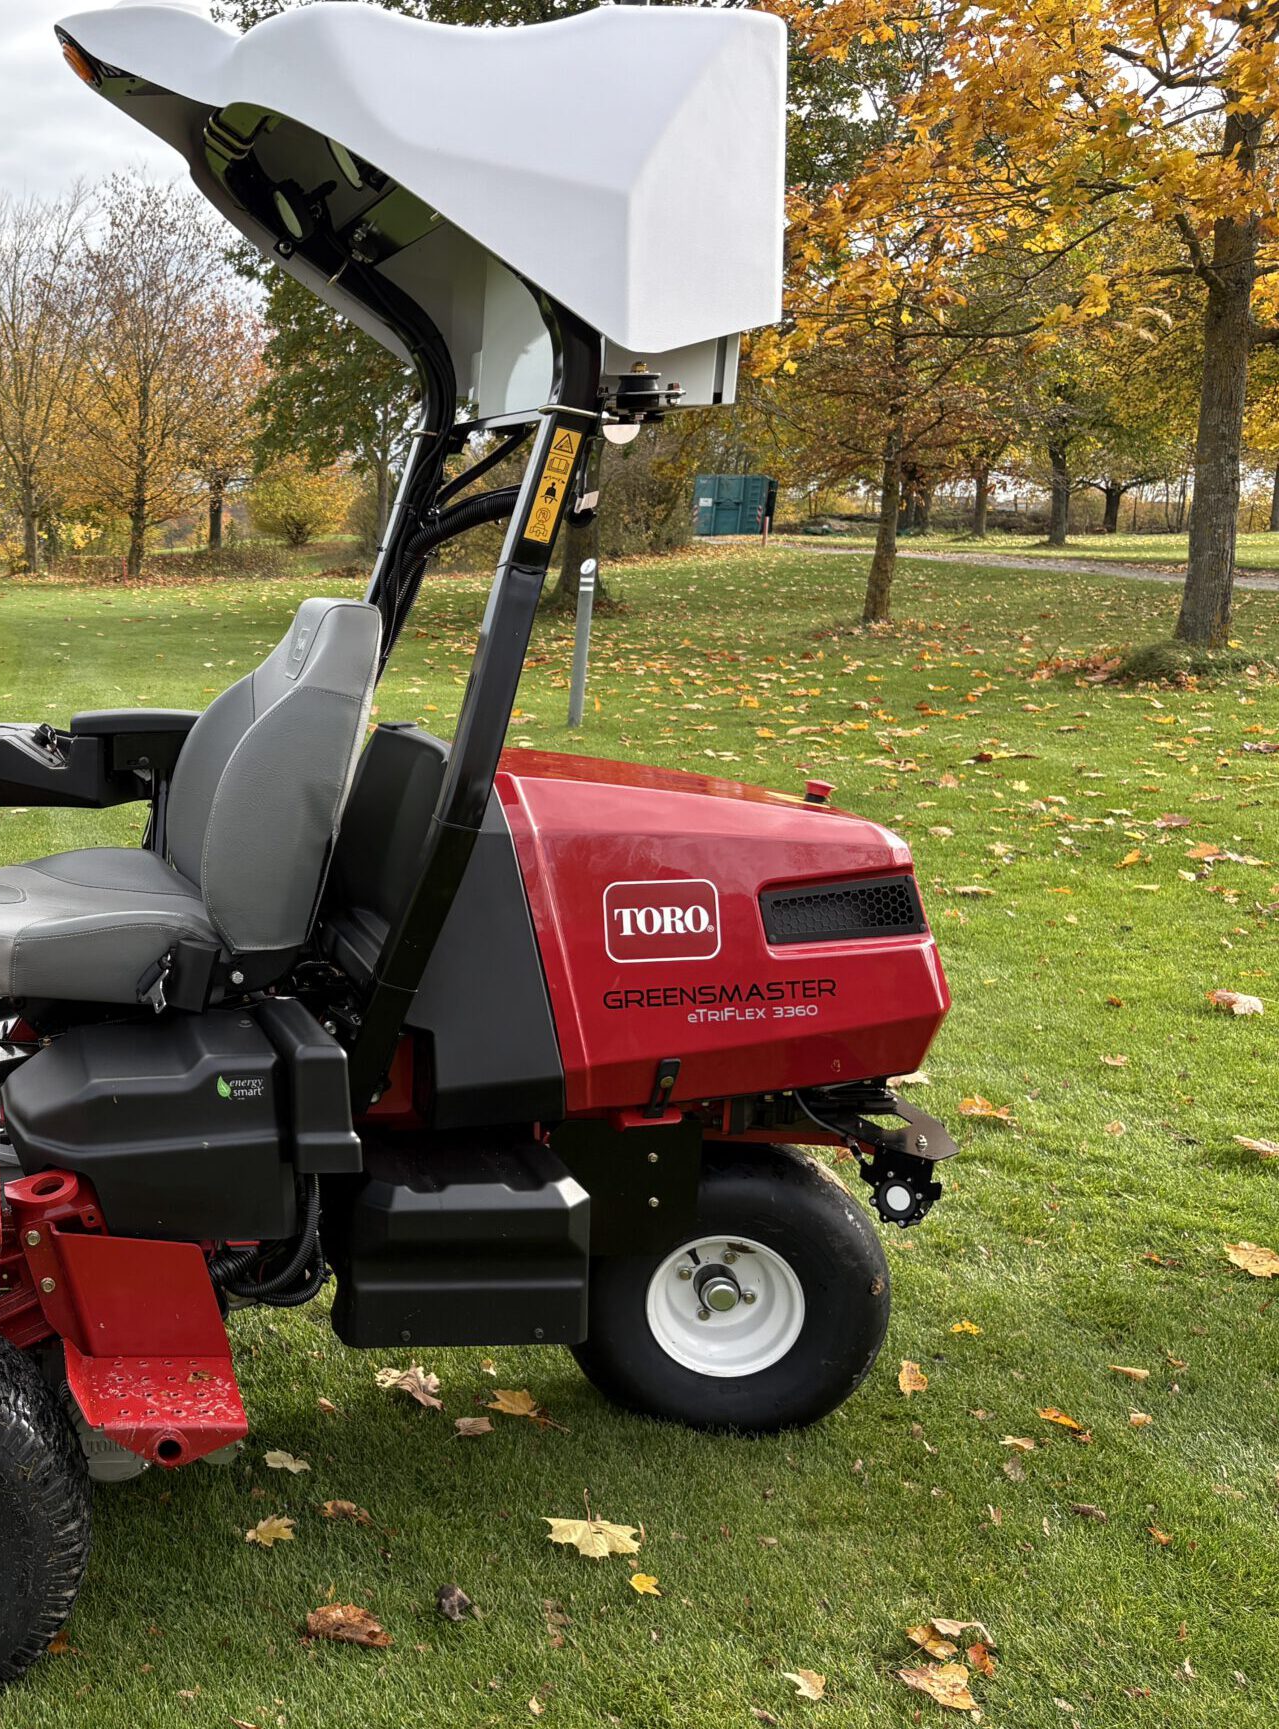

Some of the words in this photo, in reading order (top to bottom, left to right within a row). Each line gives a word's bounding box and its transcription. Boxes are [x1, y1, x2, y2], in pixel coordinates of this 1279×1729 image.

[603, 978, 837, 1010] GREENSMASTER
[772, 1004, 818, 1018] 3360
[229, 1078, 264, 1089] energy
[233, 1086, 262, 1097] smart
